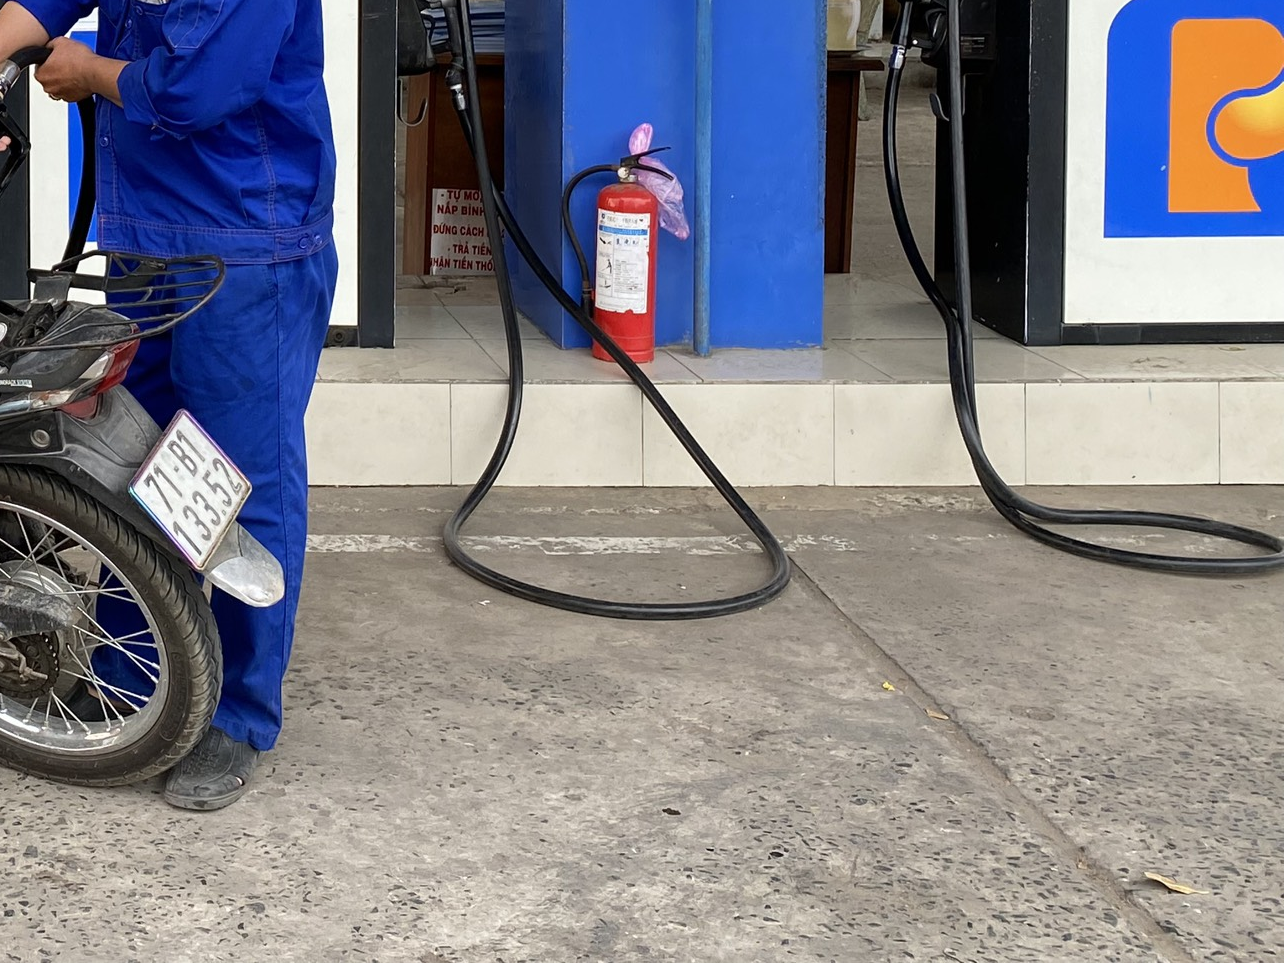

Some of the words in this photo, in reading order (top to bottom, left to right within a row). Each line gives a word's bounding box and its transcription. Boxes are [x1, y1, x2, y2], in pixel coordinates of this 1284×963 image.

[460, 224, 484, 236] CÁCH
[475, 257, 495, 271] THỐ
[173, 457, 243, 556] 133.52
